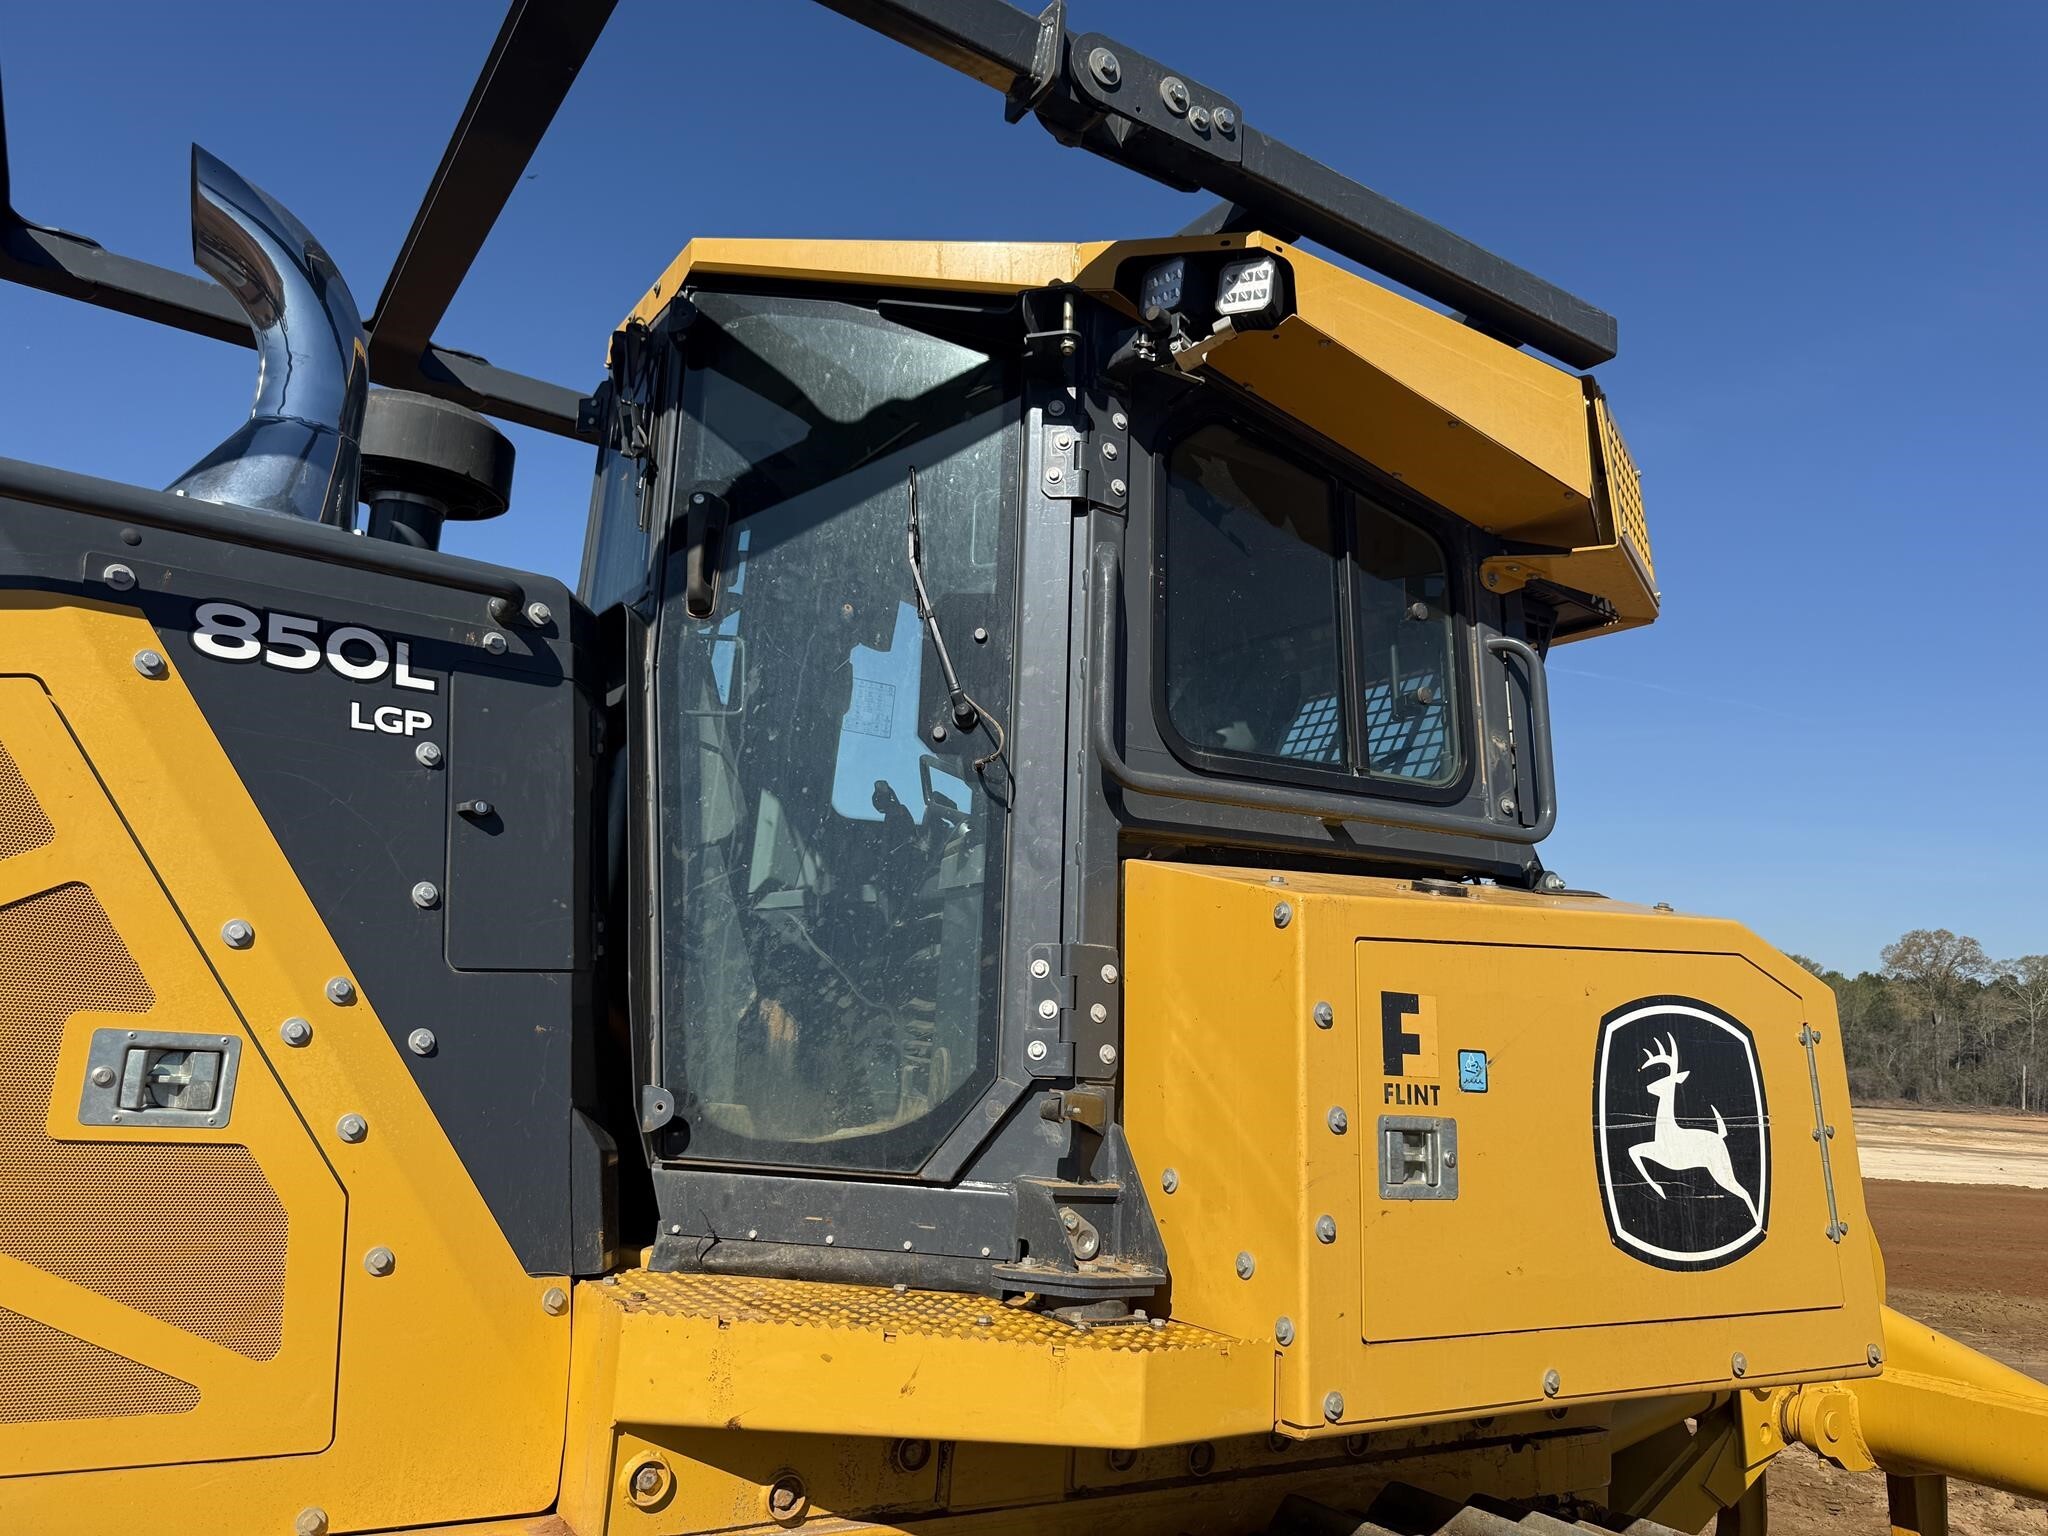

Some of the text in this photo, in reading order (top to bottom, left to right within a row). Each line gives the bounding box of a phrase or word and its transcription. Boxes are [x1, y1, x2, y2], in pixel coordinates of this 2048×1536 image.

[192, 602, 436, 691] 850L
[350, 701, 433, 736] LGP
[1380, 990, 1421, 1076] F
[1383, 1083, 1441, 1106] FLINT
